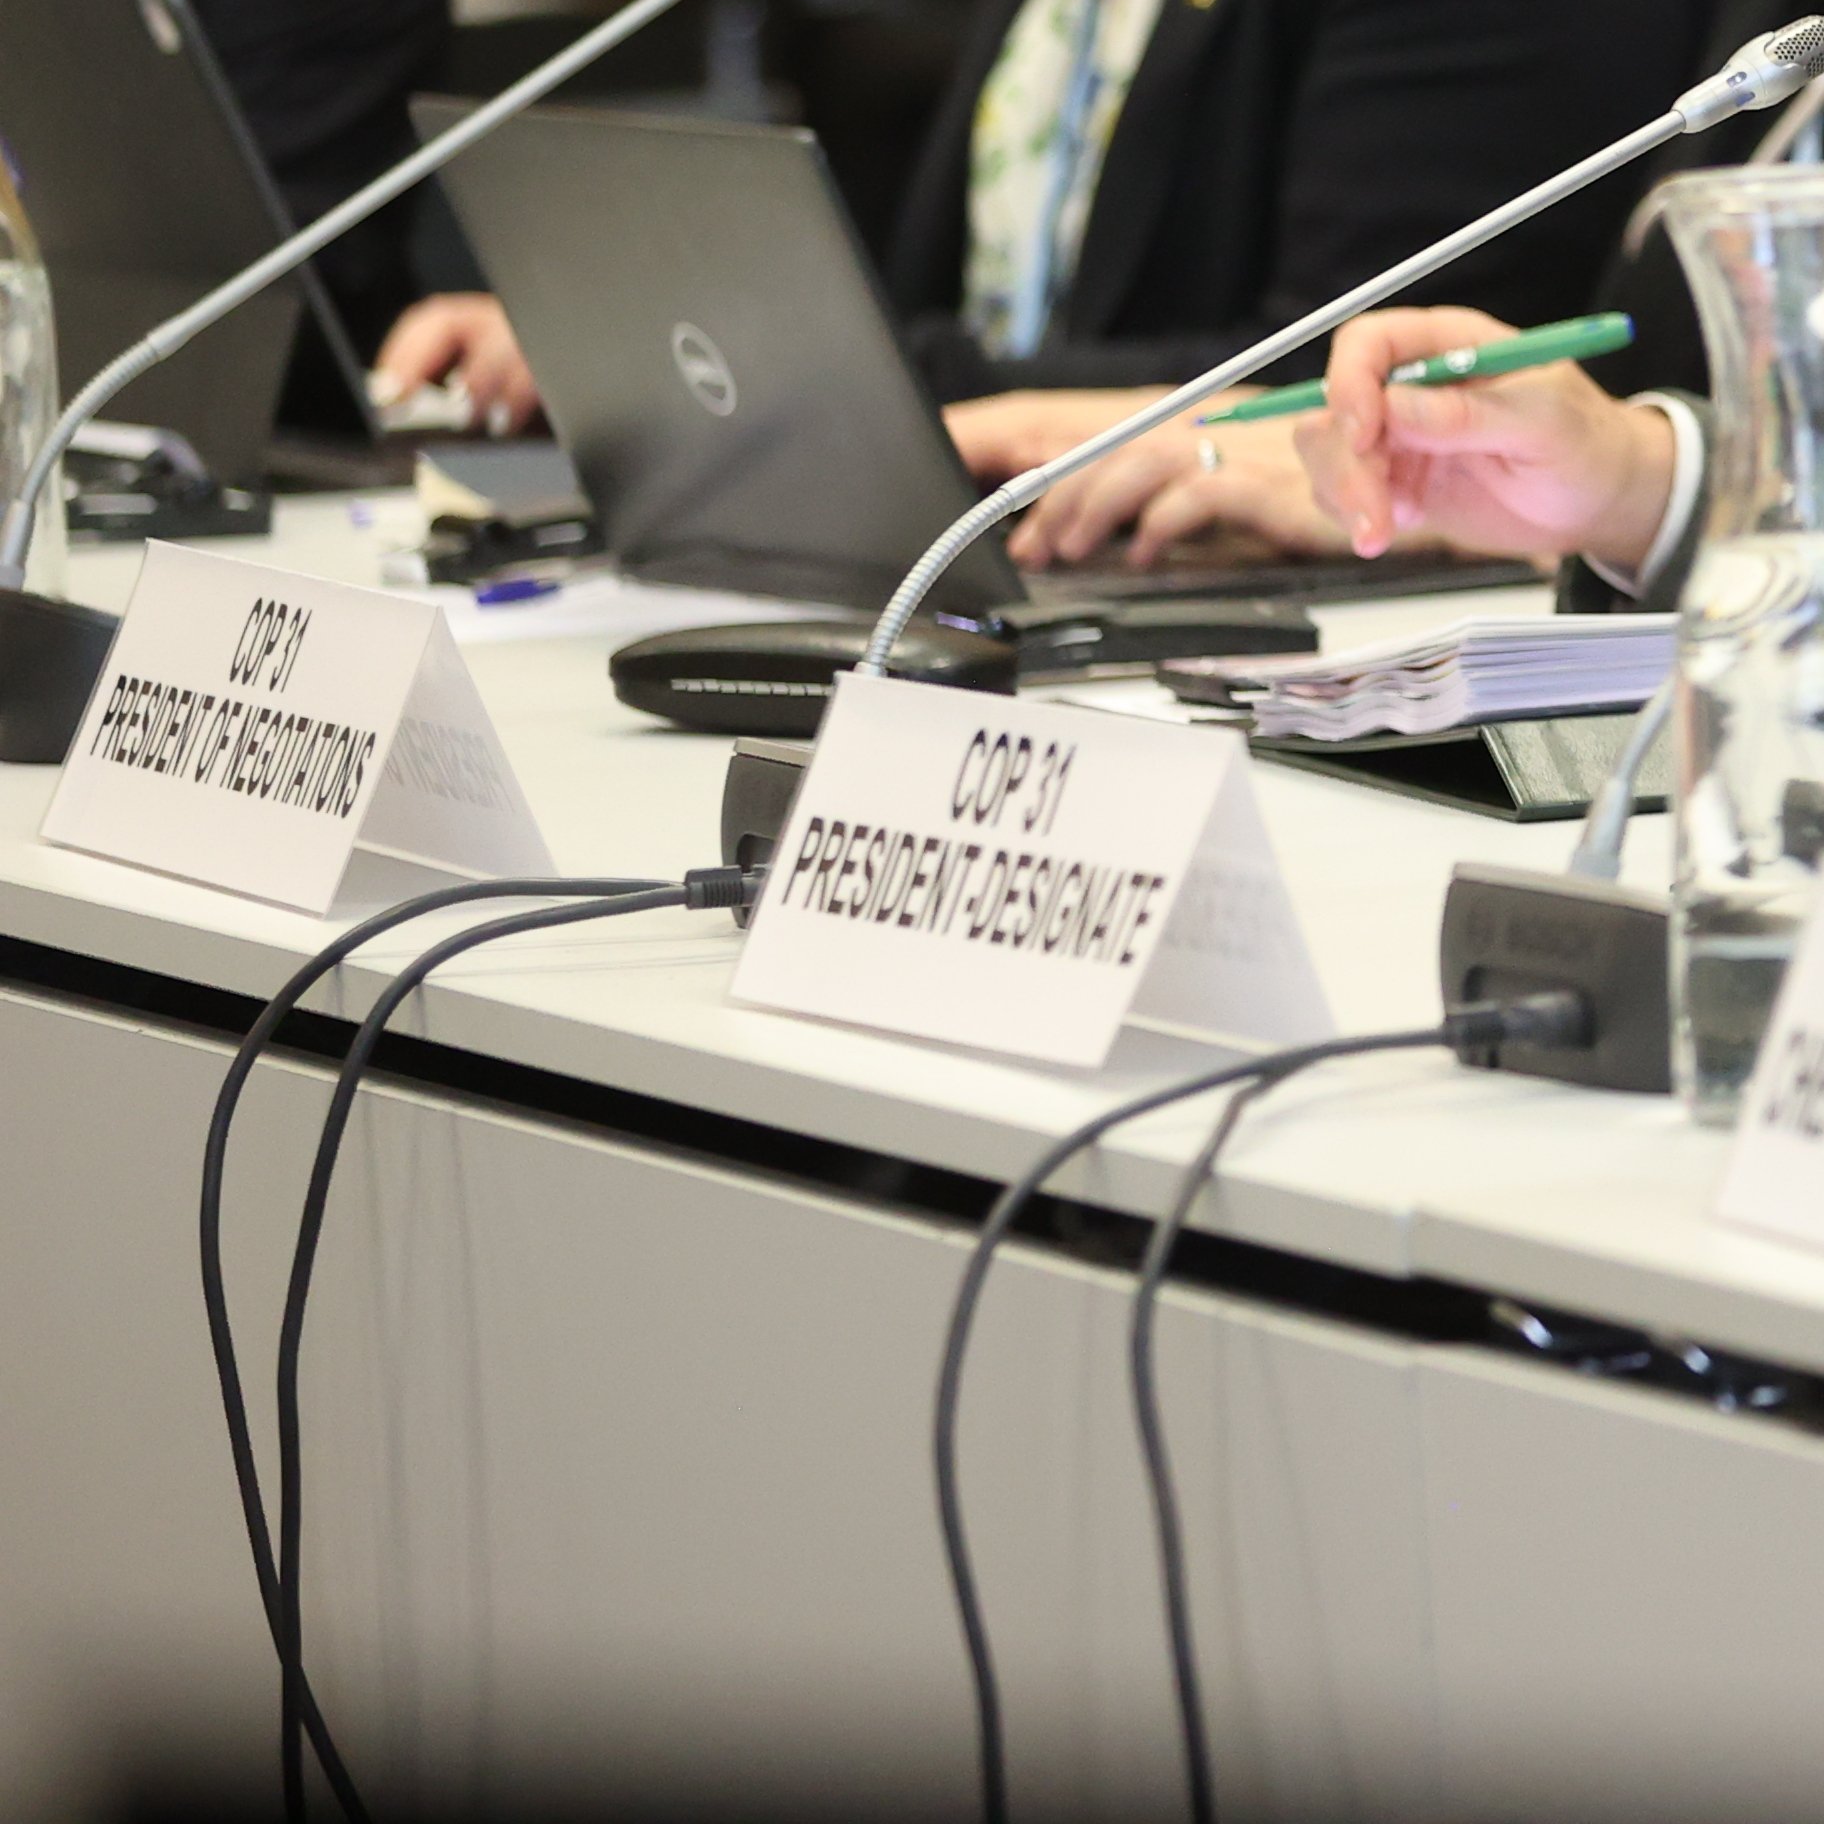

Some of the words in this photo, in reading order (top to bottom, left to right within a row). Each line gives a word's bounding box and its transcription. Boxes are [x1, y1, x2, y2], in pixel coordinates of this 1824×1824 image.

[230, 597, 288, 687] COP
[269, 607, 313, 693] 31
[91, 674, 214, 779] PRESIDENT
[195, 699, 243, 785] OF
[221, 705, 377, 818] NEGOTIATIONS
[951, 729, 1032, 826] COP
[1022, 741, 1079, 835] 31
[782, 817, 1165, 965] PRESIDENT-DESIGNATE
